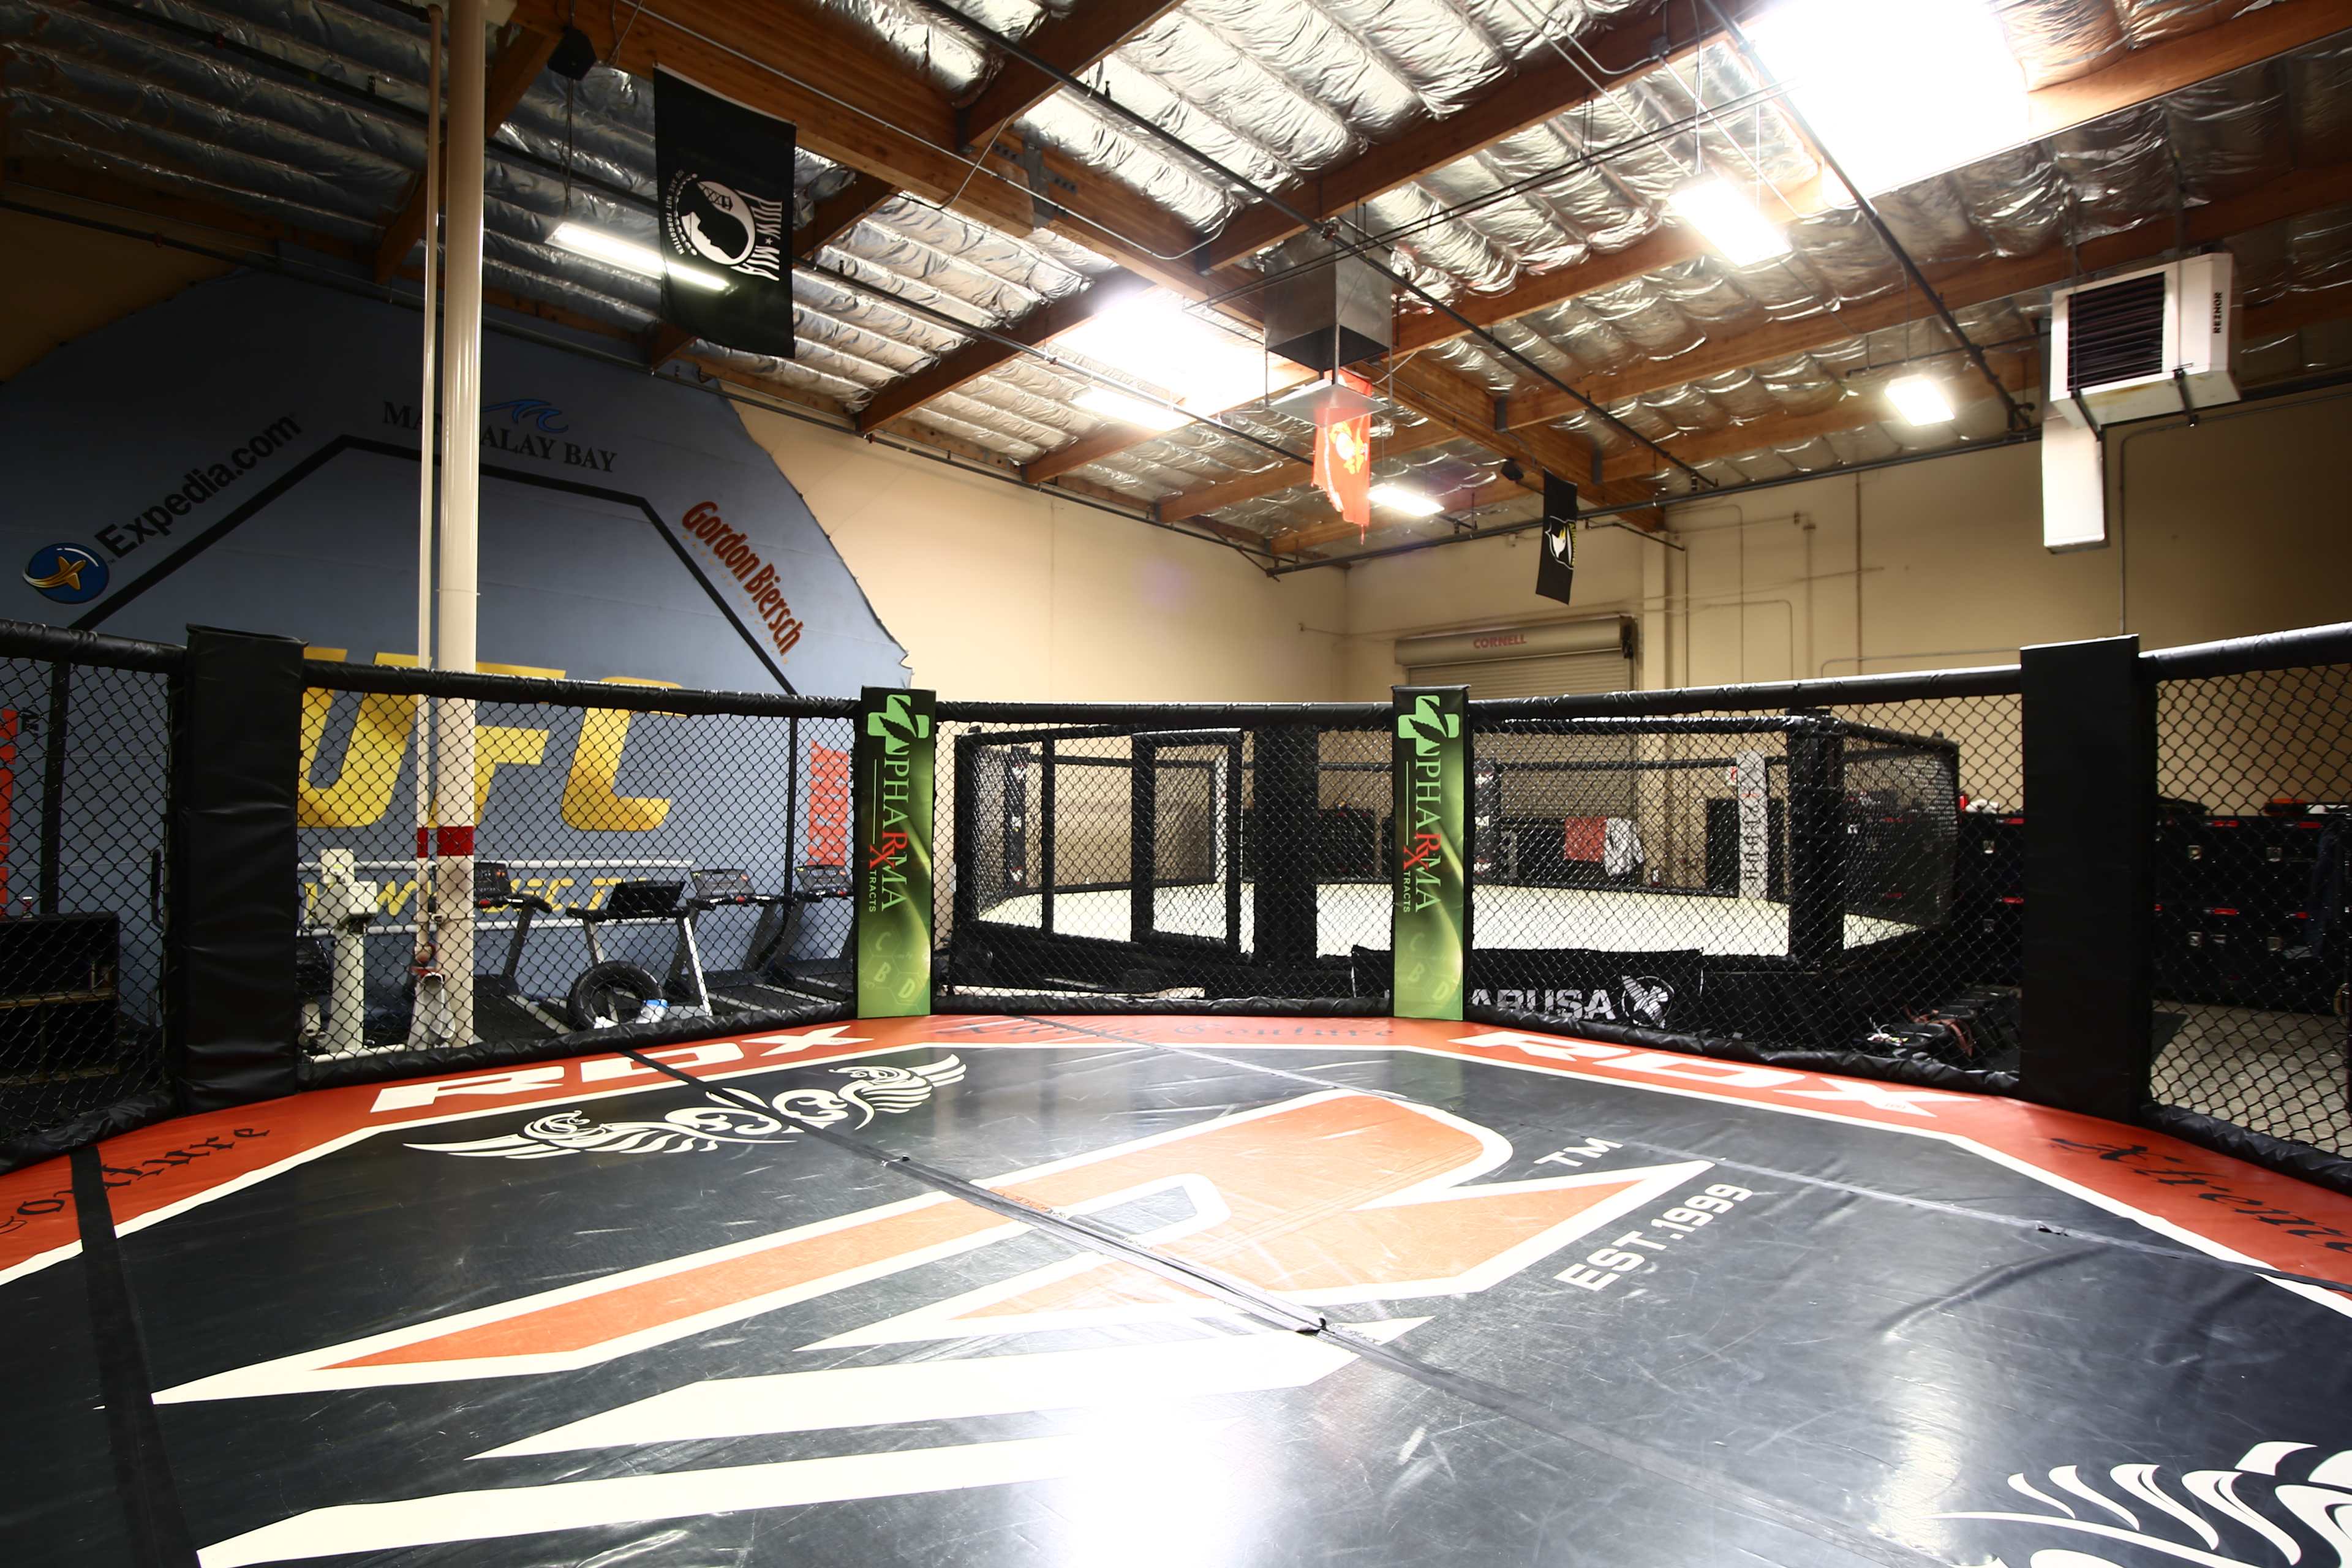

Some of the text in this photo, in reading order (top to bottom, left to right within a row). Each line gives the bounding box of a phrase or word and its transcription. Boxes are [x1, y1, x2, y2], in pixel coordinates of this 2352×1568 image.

[665, 194, 674, 210] NOT
[666, 213, 685, 255] FORGOTTEN
[563, 442, 618, 473] BAY
[94, 416, 302, 559] Expedia.com
[681, 500, 761, 582] Gordon
[742, 562, 804, 657] Biersch
[1473, 634, 1527, 649] CORNELL
[370, 1025, 875, 1113] RDX
[1448, 1031, 1983, 1118] RDX
[1534, 1137, 1624, 1167] TM
